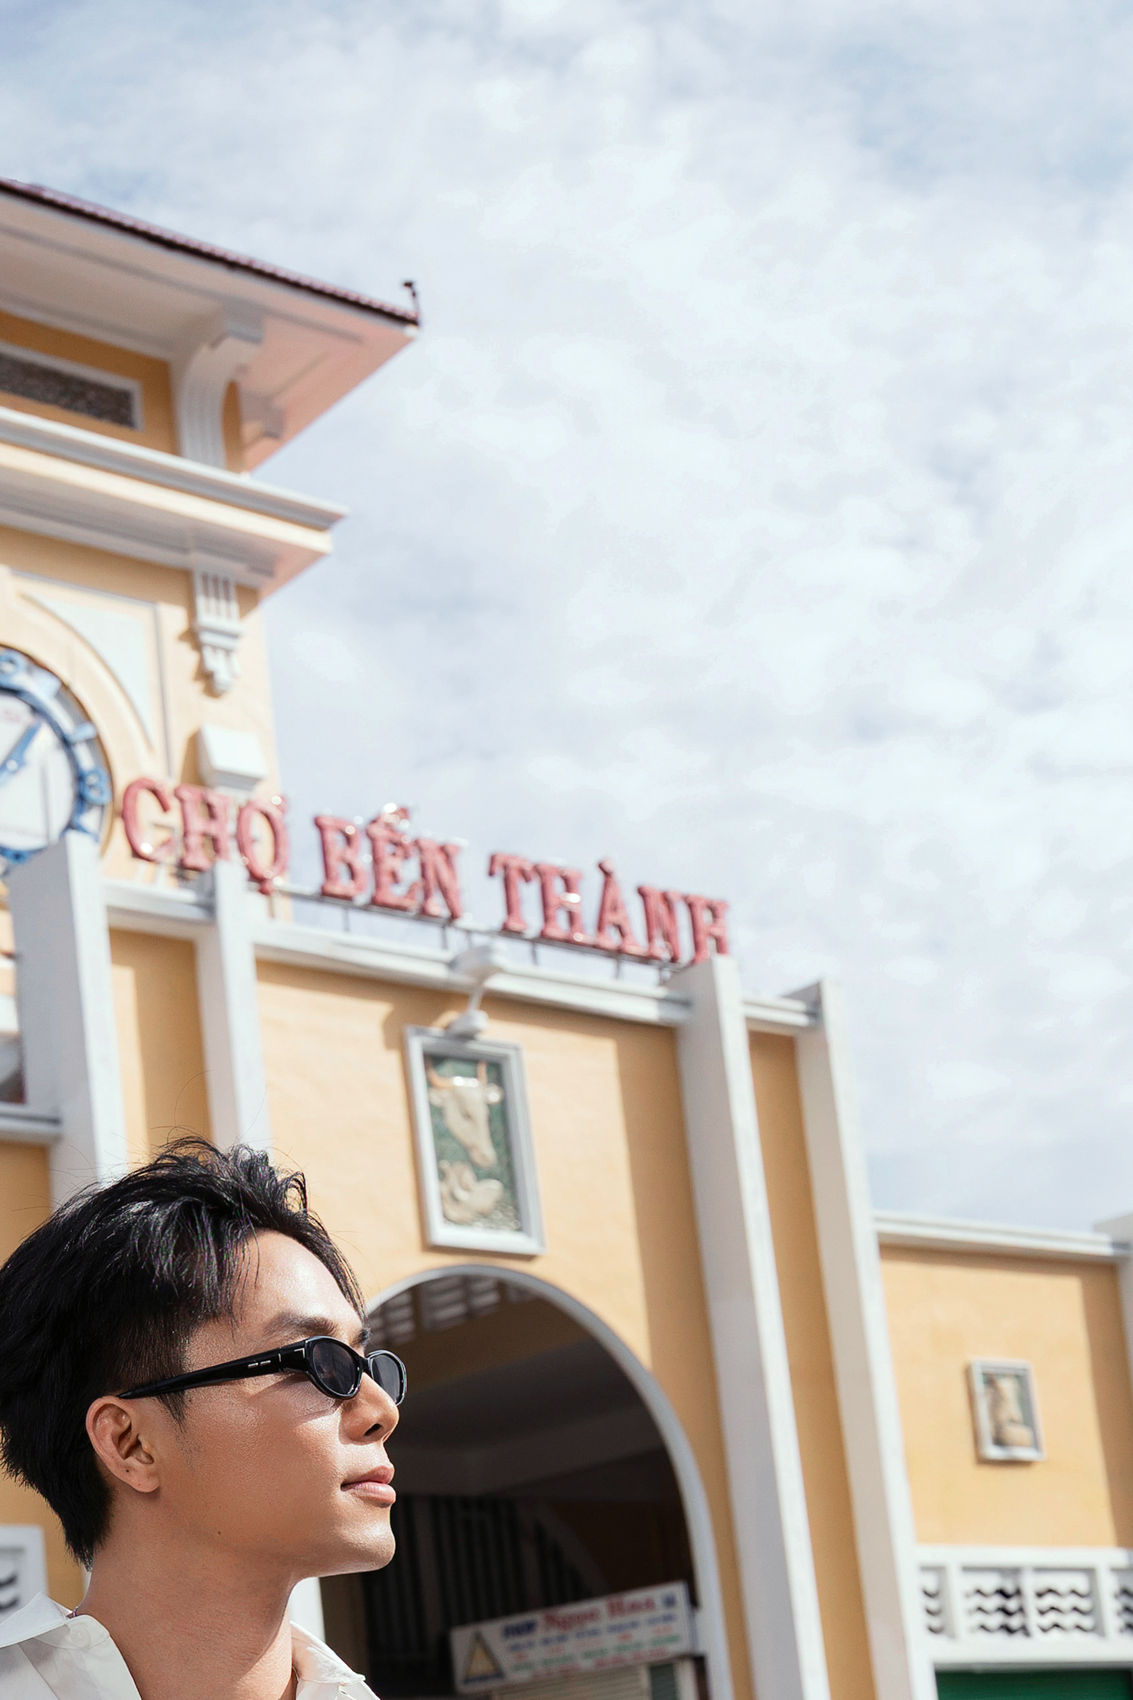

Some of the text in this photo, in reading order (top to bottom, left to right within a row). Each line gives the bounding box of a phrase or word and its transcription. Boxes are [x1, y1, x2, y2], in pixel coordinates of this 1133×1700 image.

[121, 776, 729, 964] CHỢ BẾN THÀNH
